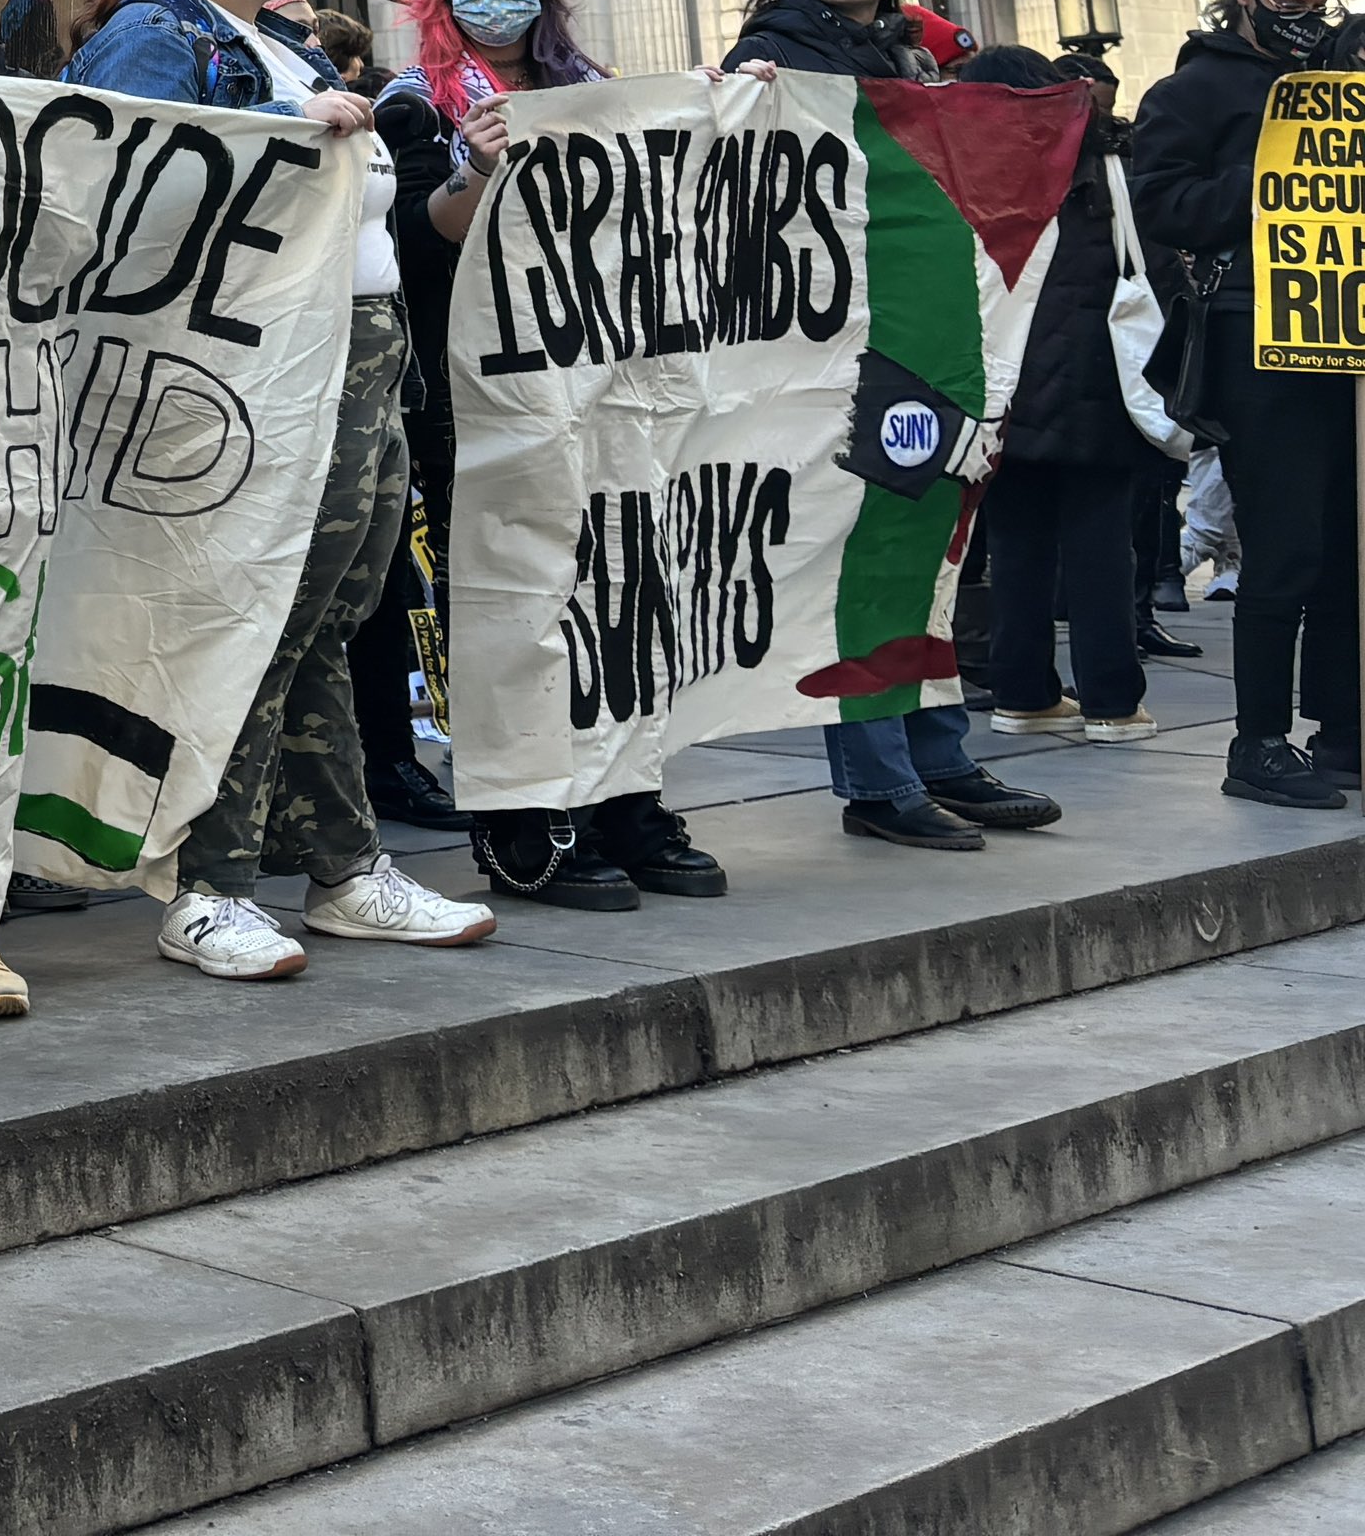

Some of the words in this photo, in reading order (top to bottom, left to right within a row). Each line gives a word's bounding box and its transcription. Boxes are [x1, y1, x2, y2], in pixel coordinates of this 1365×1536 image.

[480, 129, 701, 376] ISRAEL
[694, 129, 853, 346] BOMBS
[1269, 224, 1307, 265] IS
[1316, 226, 1344, 265] A
[1289, 353, 1323, 367] Party
[1327, 355, 1344, 367] for
[885, 412, 933, 450] SUNY
